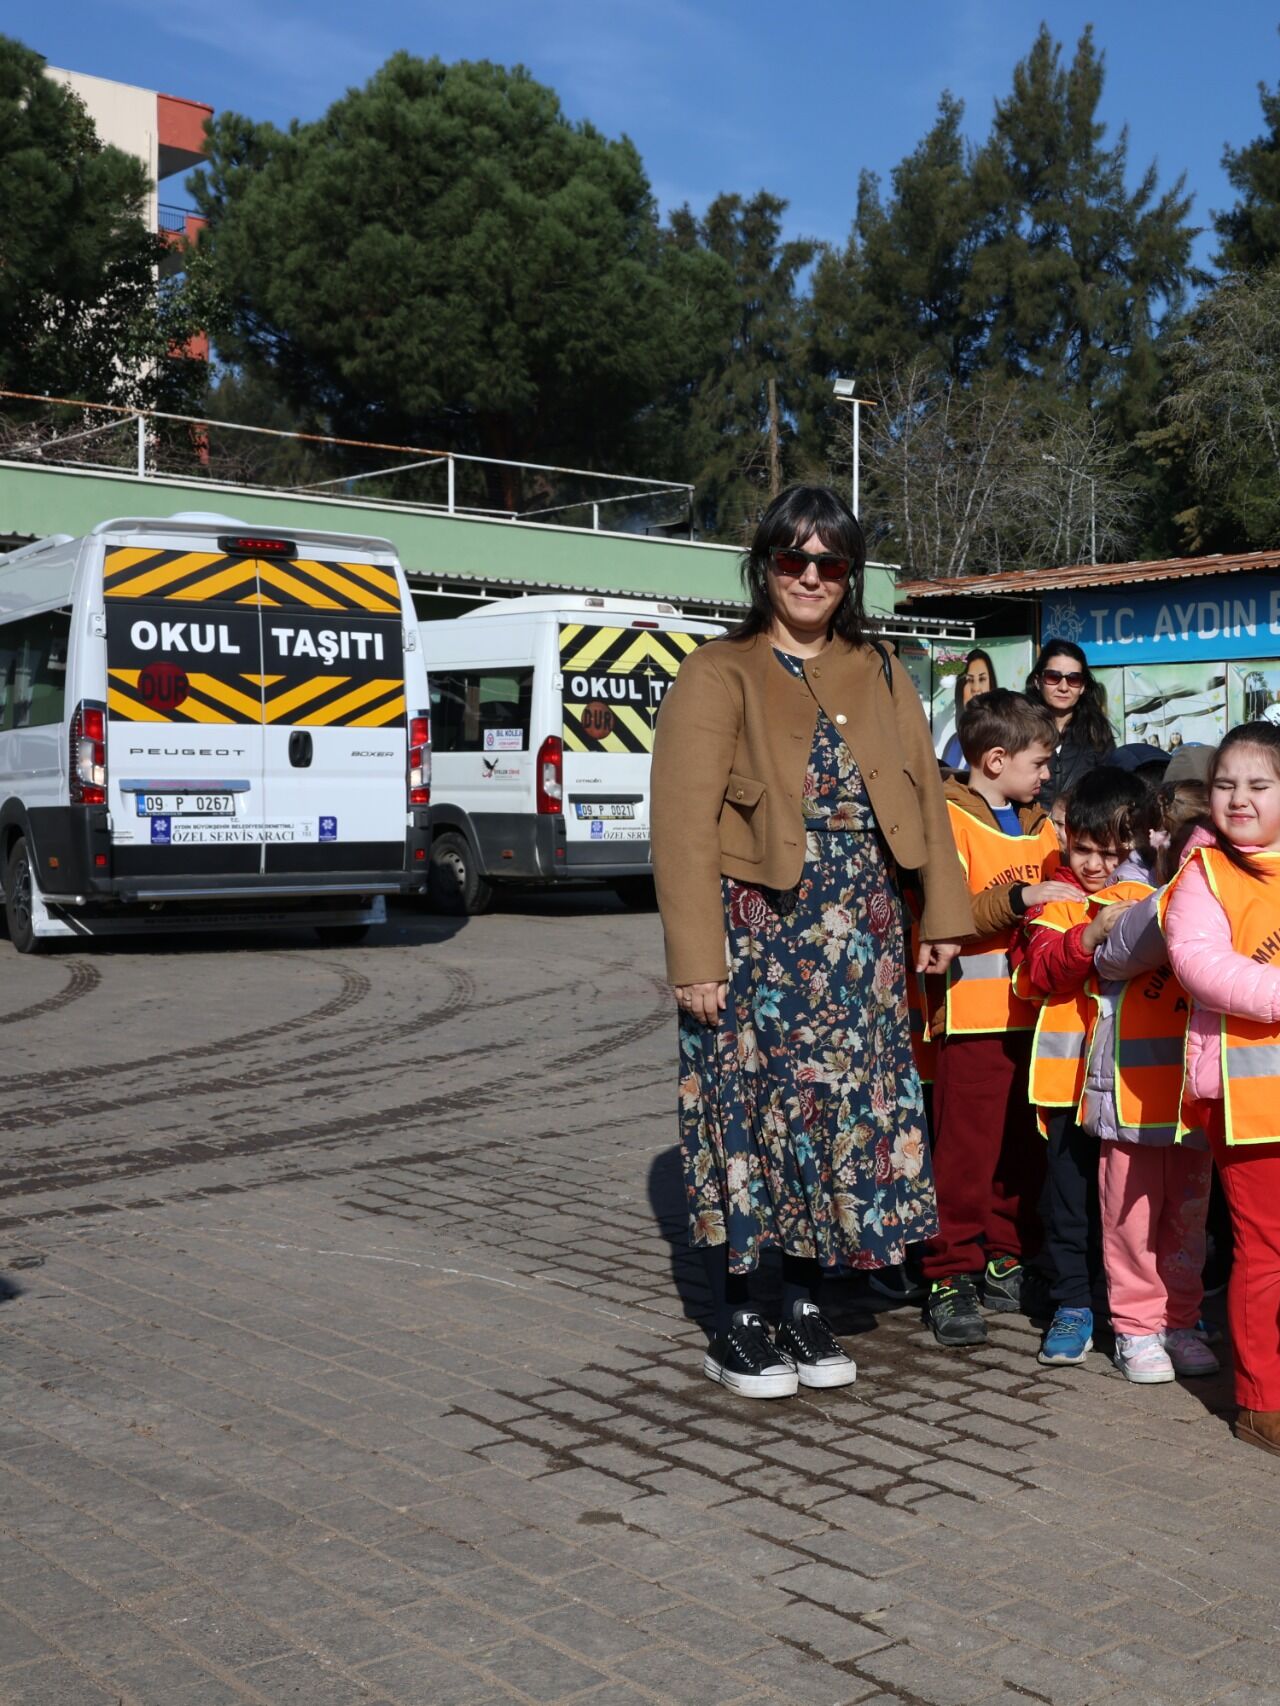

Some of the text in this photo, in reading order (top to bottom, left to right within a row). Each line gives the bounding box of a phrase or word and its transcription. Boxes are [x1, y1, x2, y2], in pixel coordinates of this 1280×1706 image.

[1089, 607, 1144, 646] T.C.
[1152, 599, 1256, 643] AYDIN
[130, 620, 385, 666] OKUL TAŞITI
[141, 672, 189, 702] DUR
[571, 675, 643, 701] OKUL
[582, 708, 614, 731] DUR
[129, 747, 246, 756] PEUGEOT
[146, 797, 230, 811] 09 P 0267
[582, 805, 631, 816] 09 P 0021
[172, 829, 295, 843] ÖZEL SERVİS ARACI
[603, 829, 650, 840] ÖZEL SERV
